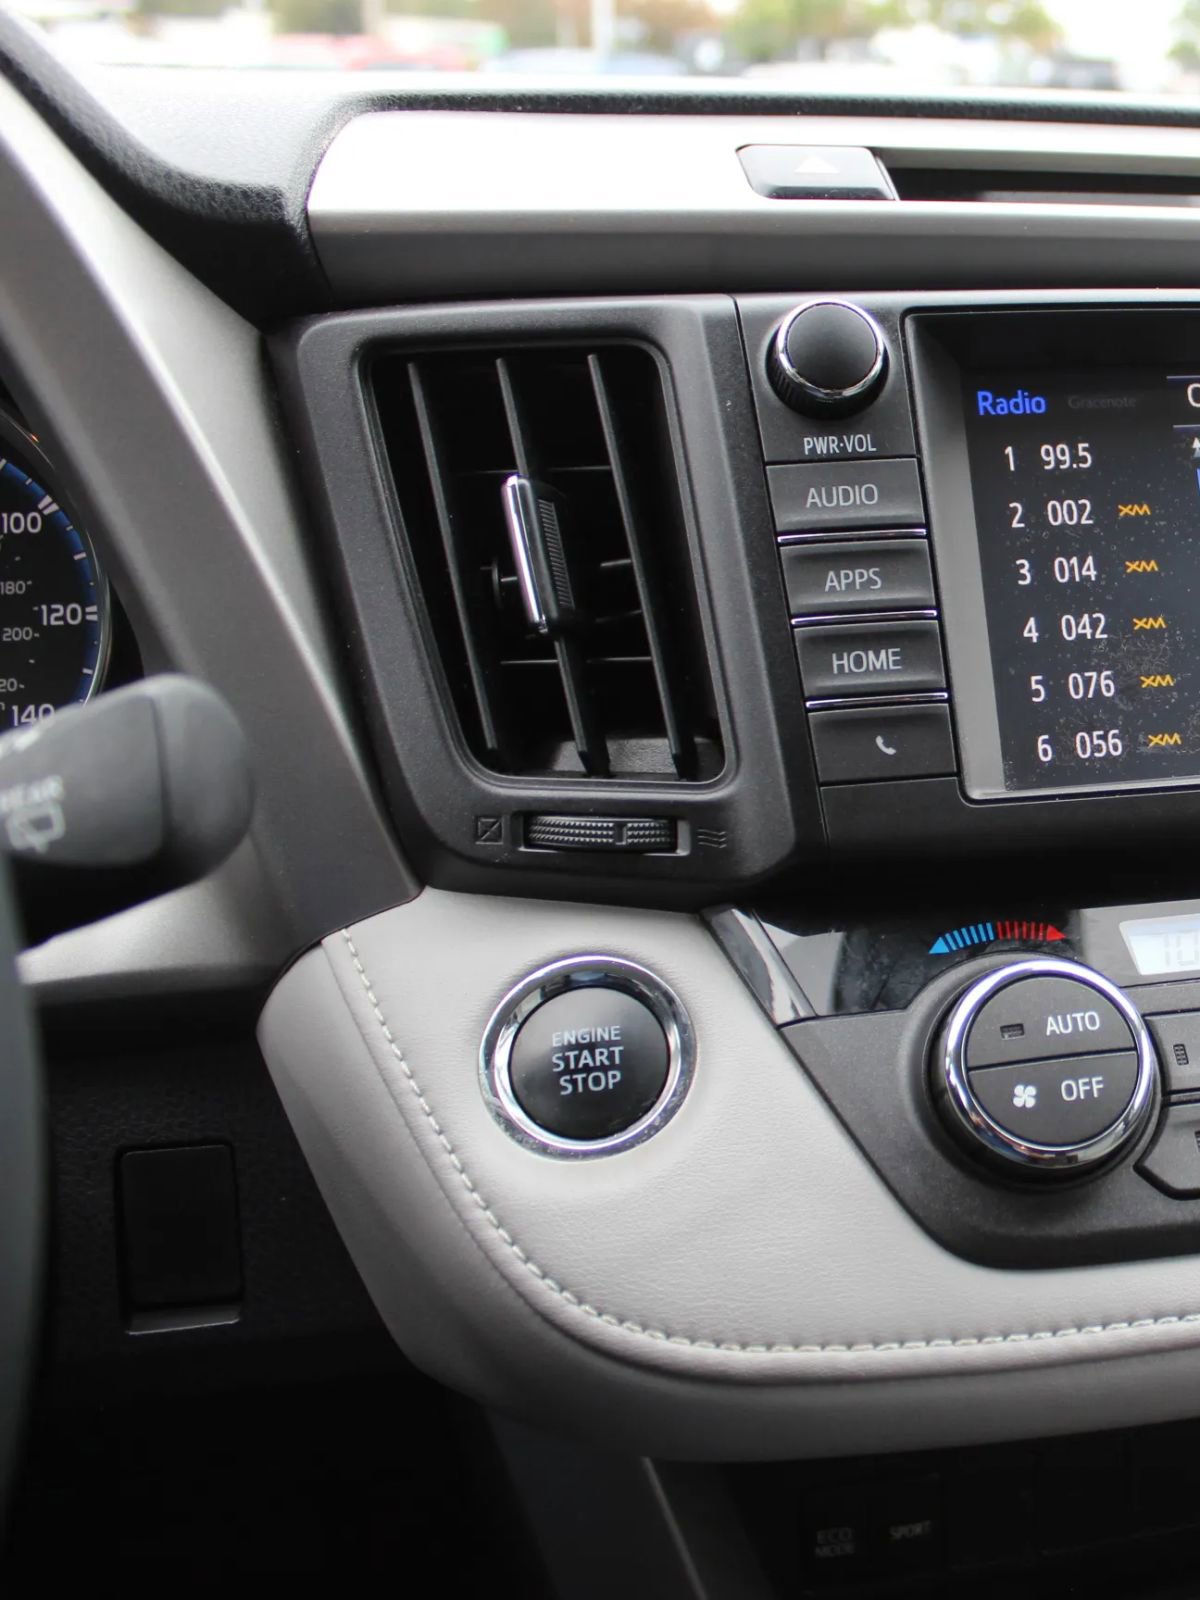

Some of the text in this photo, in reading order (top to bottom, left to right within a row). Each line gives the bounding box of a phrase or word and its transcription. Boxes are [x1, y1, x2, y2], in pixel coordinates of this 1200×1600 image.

[976, 390, 1046, 416] Radio
[1004, 442, 1093, 472] 1 99.5
[805, 483, 879, 508] AUDIO
[1, 512, 42, 534] 100
[1009, 502, 1025, 528] 2
[1047, 499, 1094, 526] 002
[824, 567, 882, 592] APPS
[1015, 559, 1031, 585] 3
[1053, 555, 1097, 583] 014
[41, 603, 82, 626] 120
[2, 626, 33, 641] 200
[1022, 617, 1039, 643] 4
[1060, 612, 1108, 641] 042
[831, 648, 903, 675] HOME
[1030, 675, 1045, 702] 5
[1067, 671, 1116, 699] 076
[11, 703, 55, 727] 140
[1036, 734, 1053, 762] 6
[1075, 729, 1123, 759] 056
[552, 1025, 622, 1047] ENGINE
[1045, 1011, 1101, 1036] AUTO
[552, 1046, 624, 1072] START
[559, 1070, 622, 1095] STOP
[1060, 1077, 1105, 1102] OFF
[889, 1520, 931, 1540] SPORT
